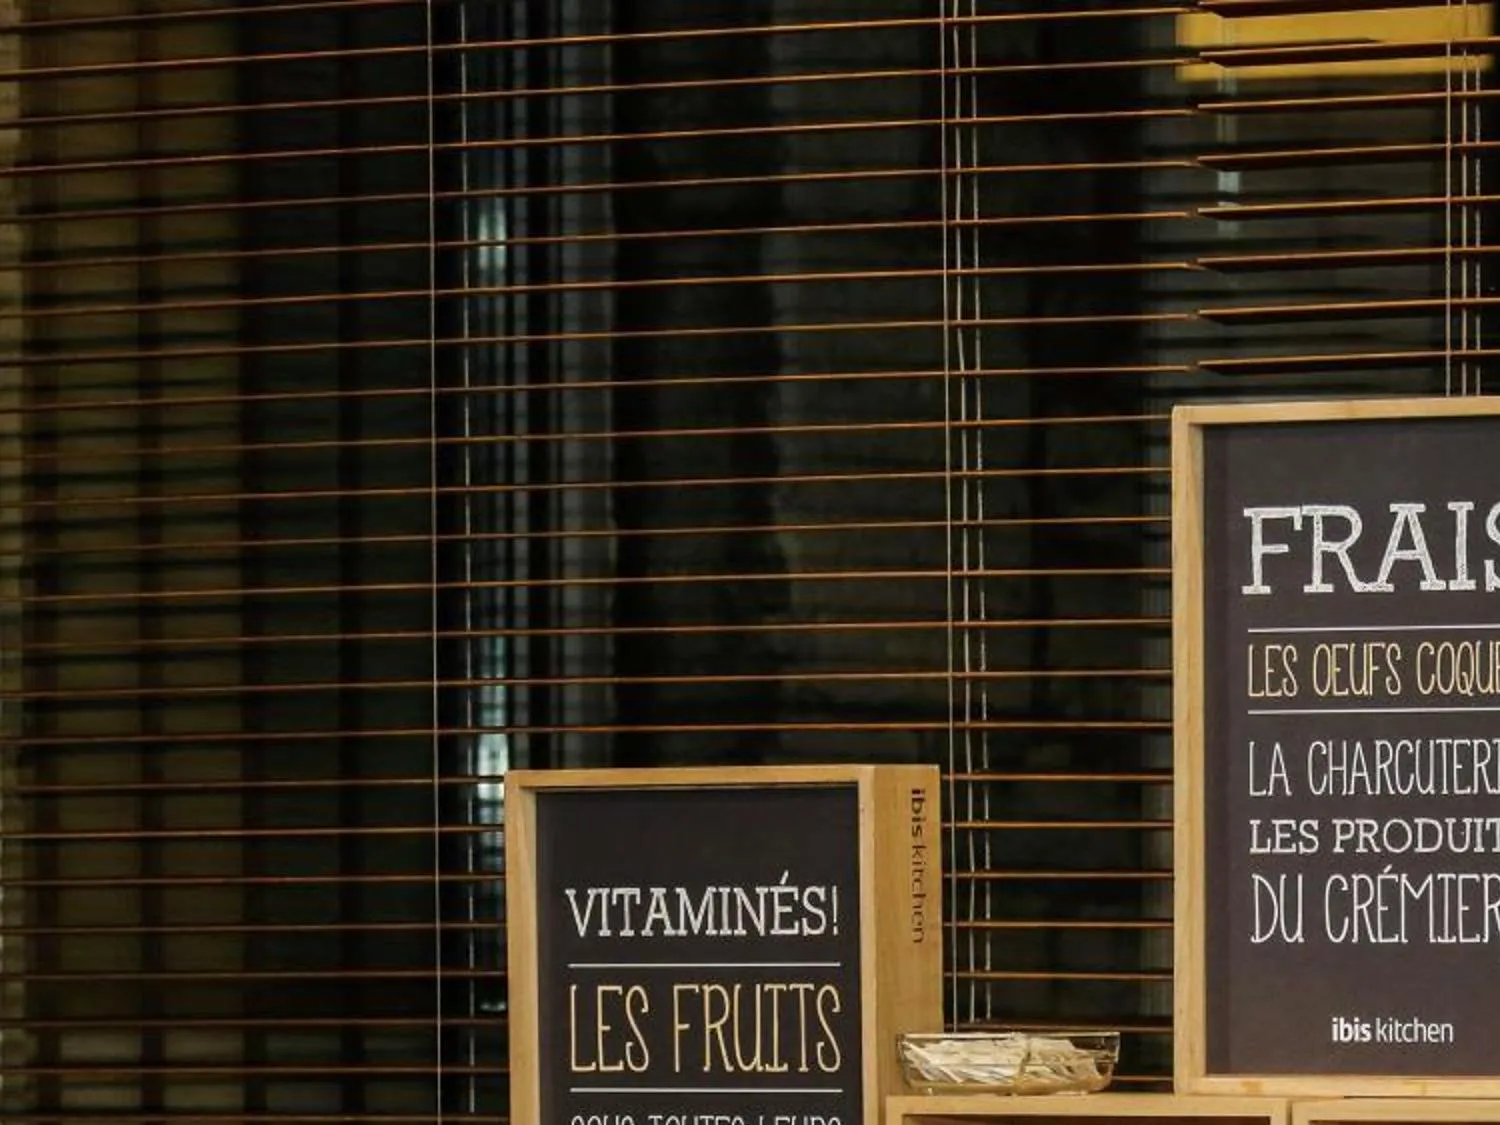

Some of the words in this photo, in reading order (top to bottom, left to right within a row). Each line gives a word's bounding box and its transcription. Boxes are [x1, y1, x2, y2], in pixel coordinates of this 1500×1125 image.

[1247, 643, 1299, 698] LES
[1312, 642, 1402, 697] OEUFS
[1249, 740, 1293, 797] LA
[1249, 819, 1319, 855] LES
[564, 870, 839, 938] VITAMINÉS!
[1250, 873, 1305, 944] DU
[570, 984, 650, 1072] LES
[673, 983, 841, 1073] FRUITS
[1332, 1016, 1372, 1043] ibis
[1375, 1017, 1454, 1043] kitchen
